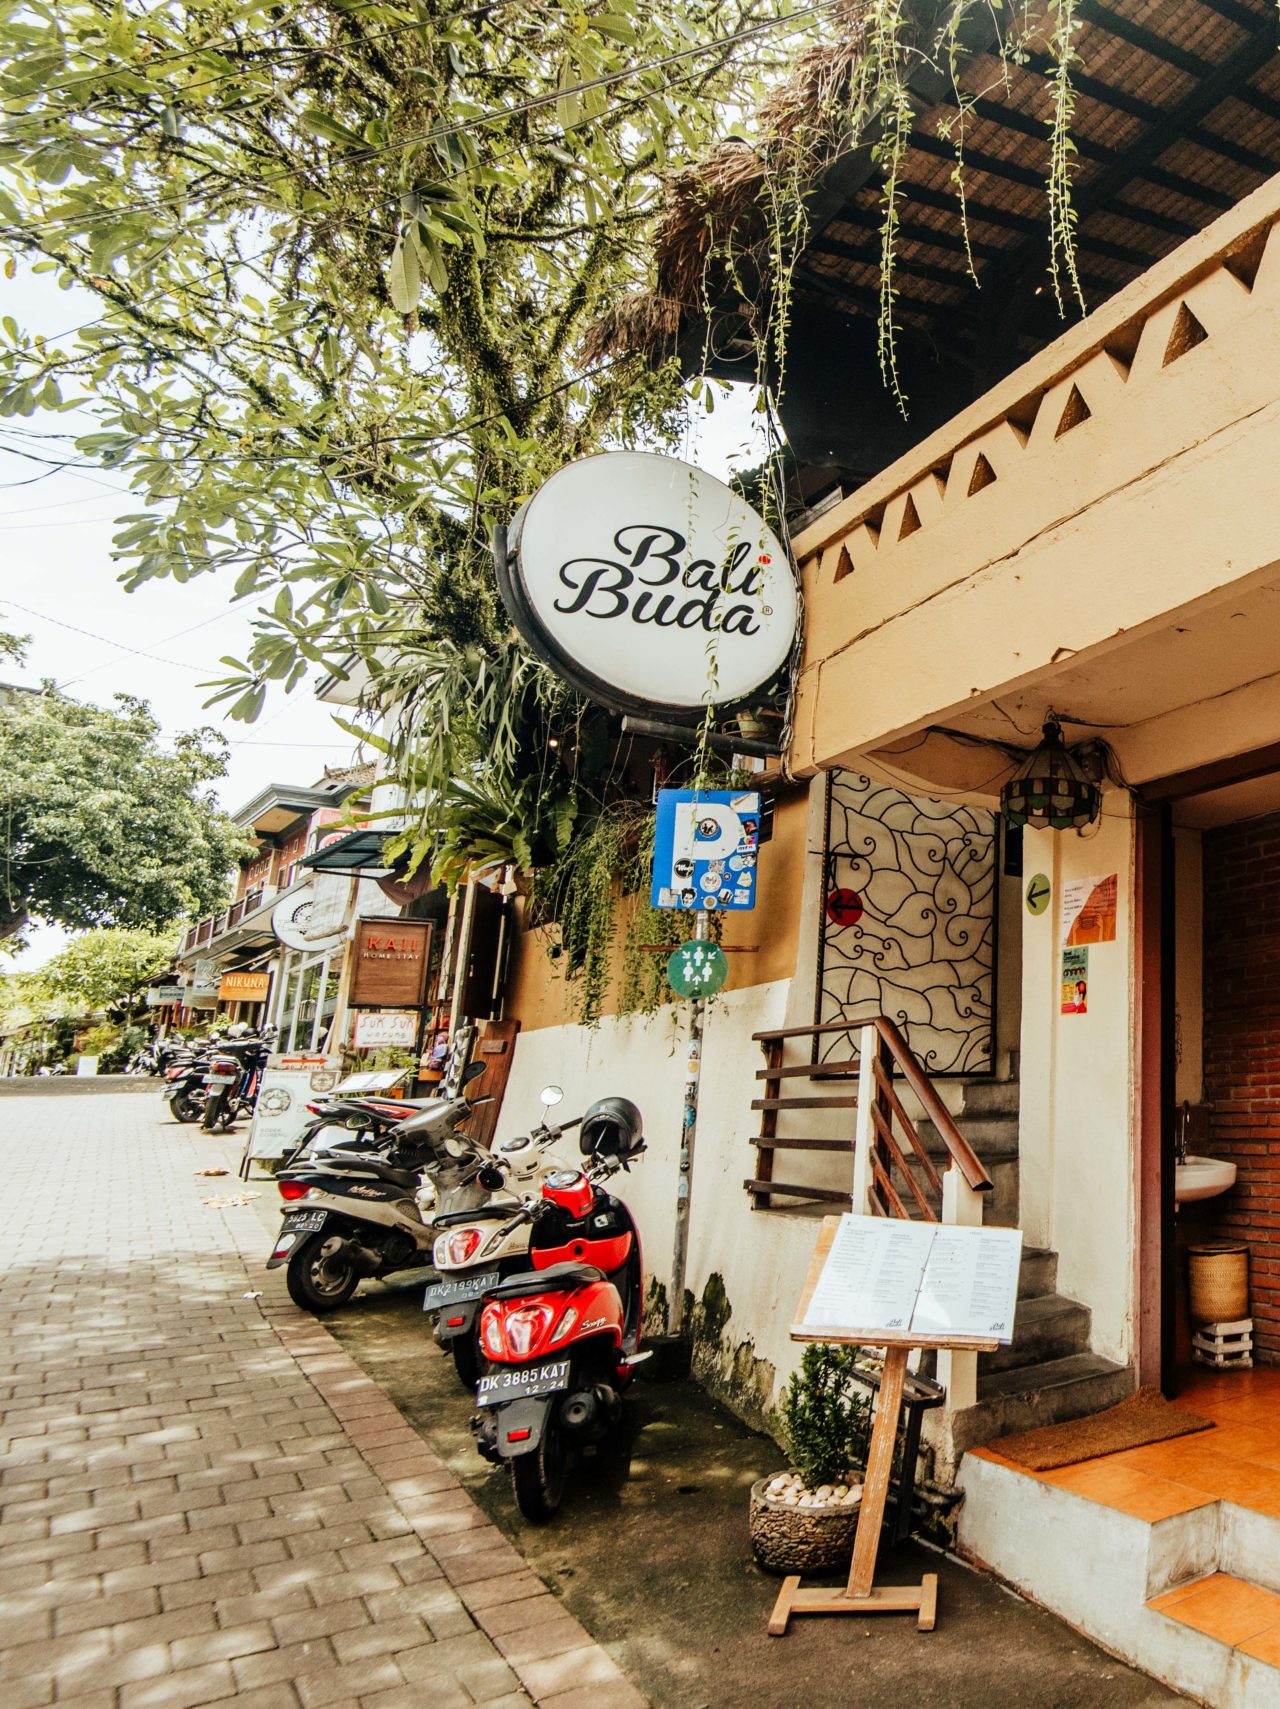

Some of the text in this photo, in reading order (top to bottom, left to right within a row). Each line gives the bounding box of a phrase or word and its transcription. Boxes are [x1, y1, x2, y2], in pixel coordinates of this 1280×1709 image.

[613, 524, 771, 597] Bali
[553, 557, 761, 636] Buda
[671, 802, 743, 893] P
[225, 976, 264, 988] NIKUNA
[363, 952, 391, 960] HOME
[480, 1362, 568, 1393] DK 3885 KAT
